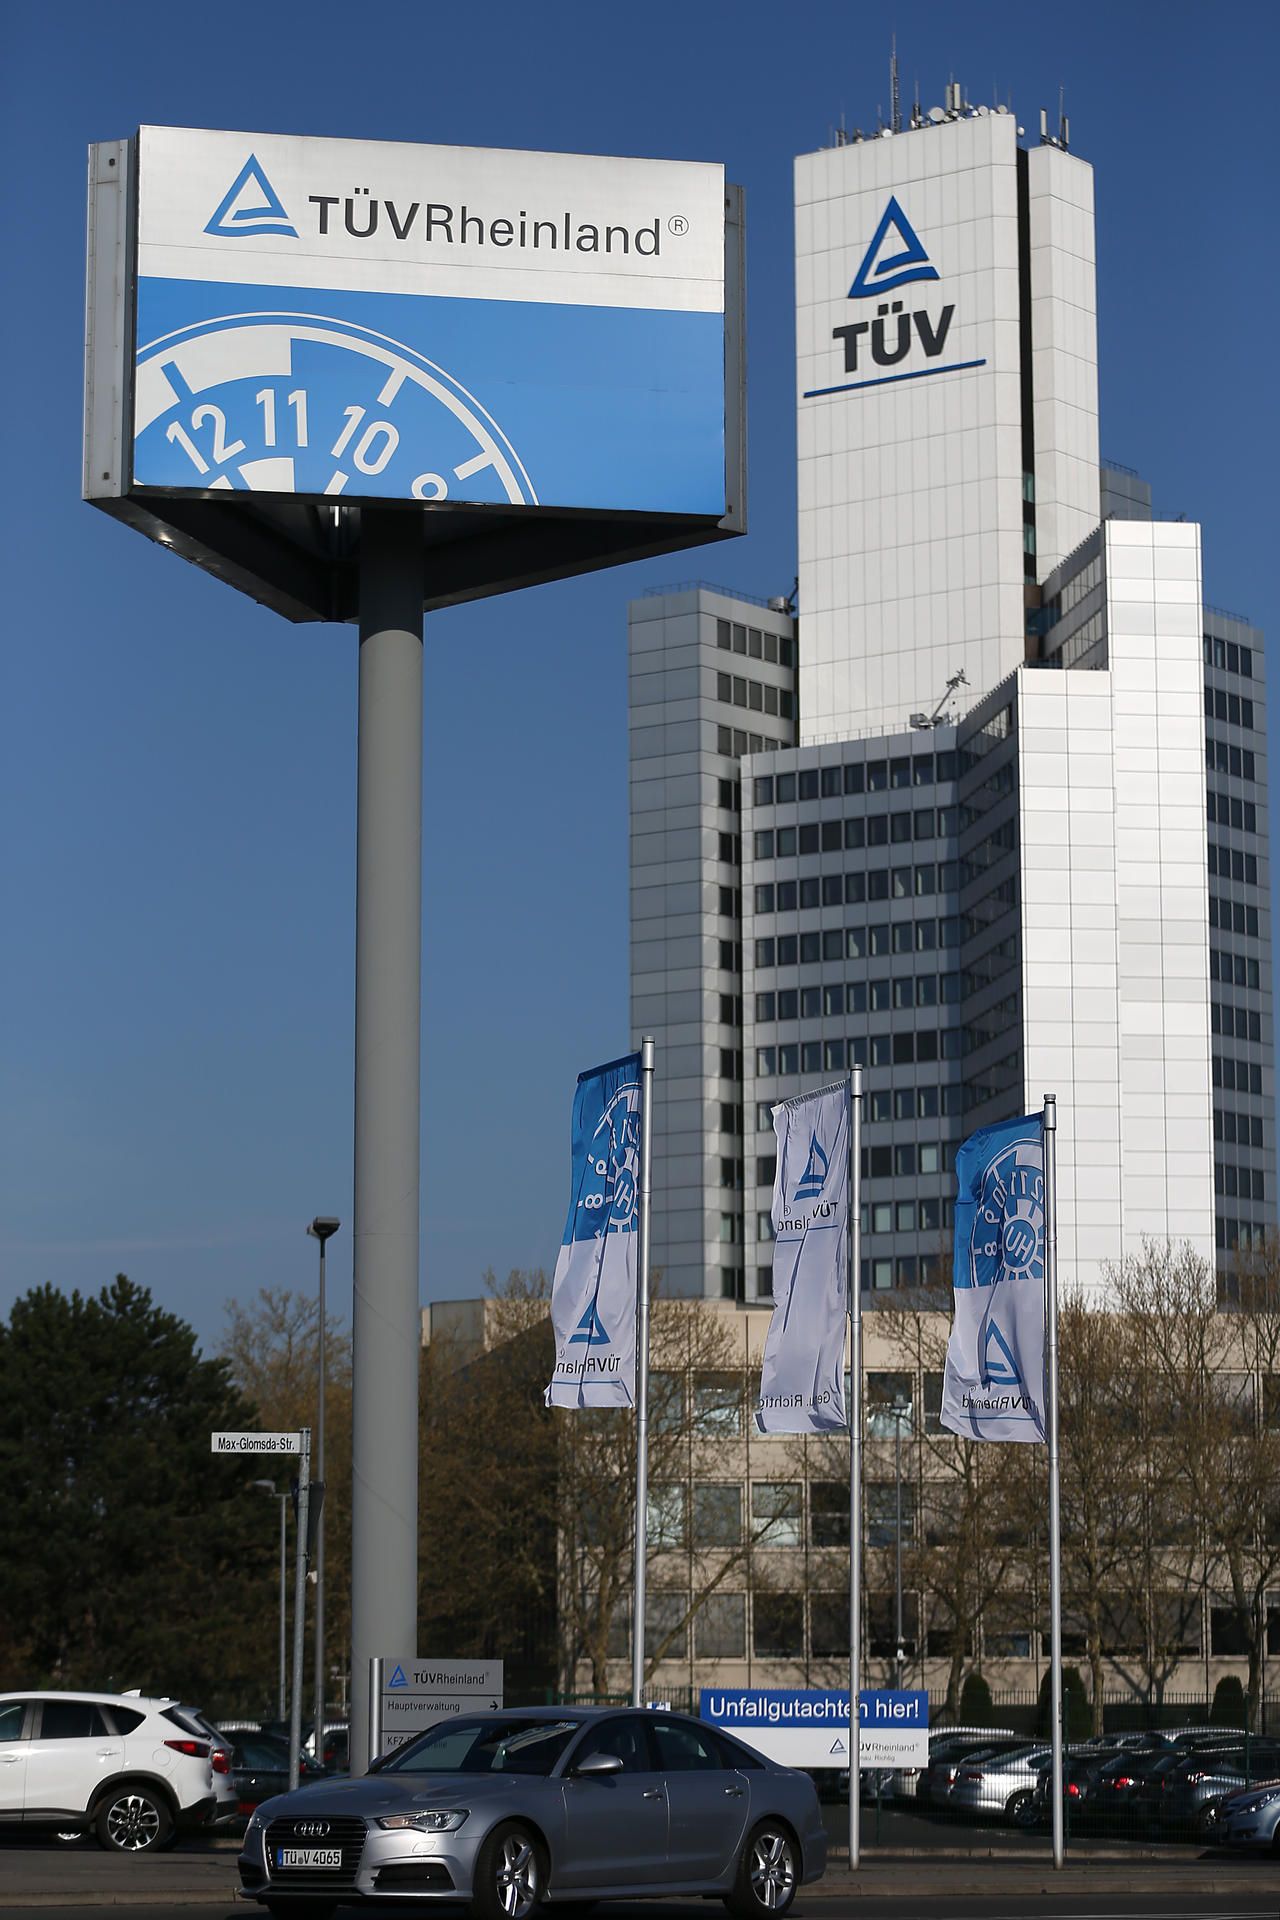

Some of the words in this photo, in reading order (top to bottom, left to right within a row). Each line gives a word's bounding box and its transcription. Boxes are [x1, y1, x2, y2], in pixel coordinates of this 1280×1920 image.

[832, 300, 956, 374] TÜV
[165, 404, 247, 475] 12
[255, 388, 309, 448] 11
[331, 405, 400, 476] 10
[217, 1437, 295, 1450] Max-Glomsda-Str.
[387, 1701, 460, 1713] Hauptverwaltung
[709, 1696, 869, 1722] Unfallgutachten
[875, 1698, 919, 1719] hier!
[313, 1850, 341, 1865] 4065
